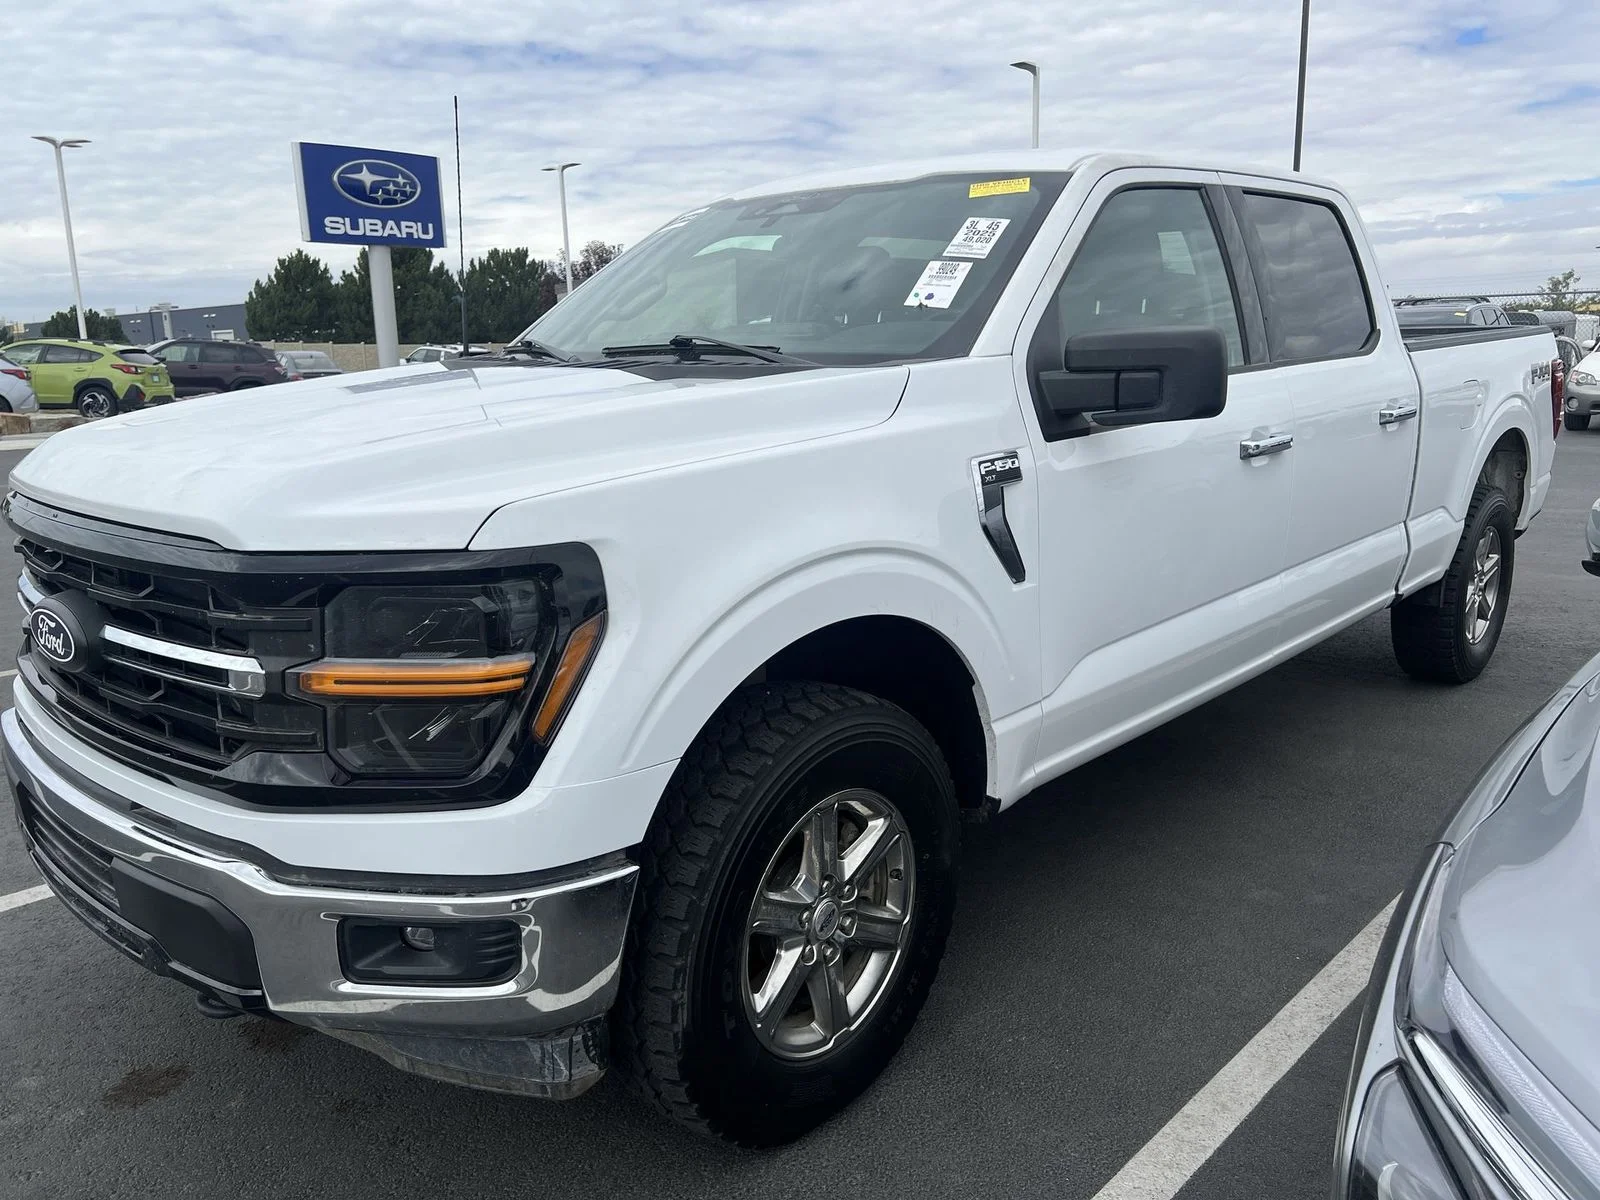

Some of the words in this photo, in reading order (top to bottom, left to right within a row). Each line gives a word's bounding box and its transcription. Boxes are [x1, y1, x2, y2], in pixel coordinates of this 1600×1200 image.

[324, 216, 434, 240] SUBARU
[966, 220, 978, 230] 3L
[986, 221, 1001, 231] 45
[962, 236, 992, 244] 49,020
[963, 229, 997, 238] 2025
[980, 458, 1020, 475] F-150
[38, 614, 66, 656] Ford
